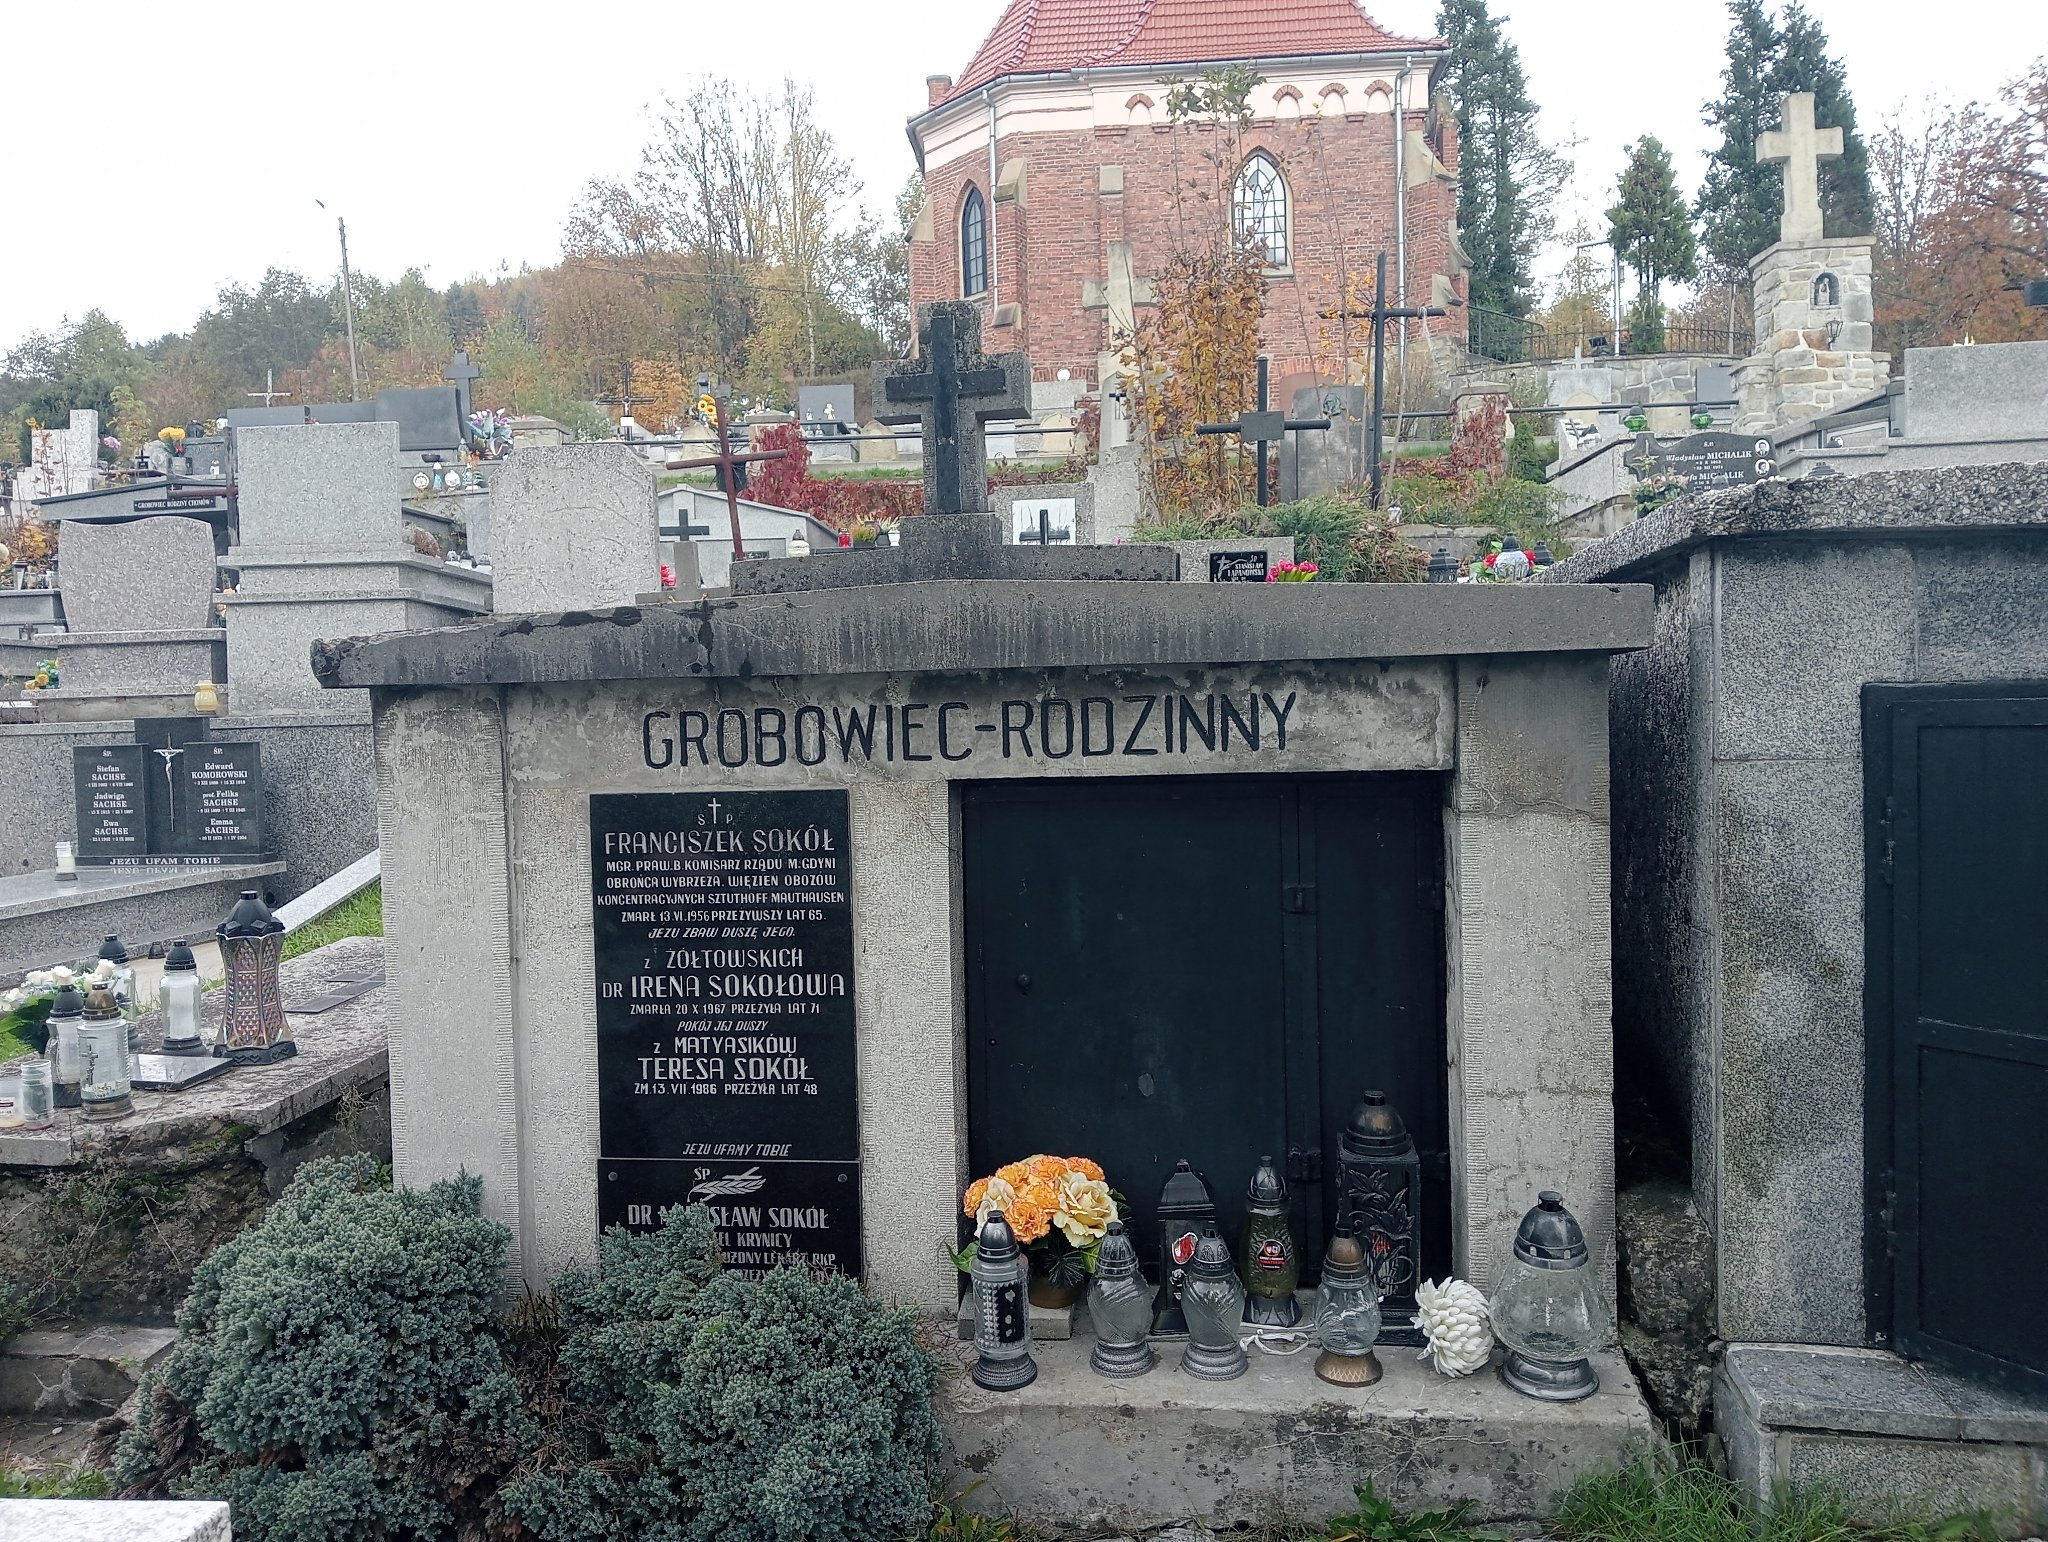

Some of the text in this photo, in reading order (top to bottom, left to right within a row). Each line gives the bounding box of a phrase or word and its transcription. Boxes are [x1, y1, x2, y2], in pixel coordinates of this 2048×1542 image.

[1707, 451, 1753, 460] MICHALIK
[1699, 471, 1744, 480] MICALIK
[204, 762, 234, 770] Edward
[91, 773, 126, 781] SACHSE
[191, 770, 248, 779] KOMOROWSKI
[94, 792, 125, 800] Jadwiga
[216, 790, 239, 798] Feliks
[93, 800, 128, 808] SACHSE
[203, 799, 239, 807] SACHSE
[103, 819, 119, 827] Ewa
[210, 818, 234, 826] Emma
[94, 827, 129, 835] SACHSE
[204, 826, 240, 834] SACHSE
[604, 823, 835, 855] FRANCISZEK SOKÓŁ
[110, 857, 221, 865] JEZU UFAM TOBIE
[744, 858, 783, 872] RZĄDU
[606, 874, 659, 889] OBROŃCA
[784, 871, 837, 887] OBOZÓW
[597, 891, 845, 906] KONCENTRACYJNYCH SZTUTHOFF MAUTHAUSEN
[621, 911, 657, 923] ZMARŁ
[711, 906, 784, 922] PRZEŻYWSZY
[787, 909, 806, 921] LAT
[682, 926, 719, 938] ZBAW
[721, 926, 760, 940] DUSZĘ
[665, 946, 803, 970] ŻÓŁTOWSKICH
[602, 973, 846, 998] DR IRENA SOKOŁOWA
[630, 1002, 821, 1015] ZMARŁA 20 X 1967 PRZEŻYŁA LAT 71
[677, 1018, 770, 1032] POKÓJ JEJ DUSZY
[674, 1033, 798, 1054] MATYASIKÓW
[637, 1053, 815, 1080] TERESA SOKÓŁ
[724, 1081, 776, 1095] PRZEŻYŁA
[781, 1083, 800, 1095] LAT
[803, 1083, 819, 1095] 48
[682, 1143, 793, 1157] JEZU UFAMY TOBIE
[627, 1204, 653, 1225] DR
[768, 1205, 830, 1229] SOKÓŁ
[737, 1231, 793, 1249] KRYNICY
